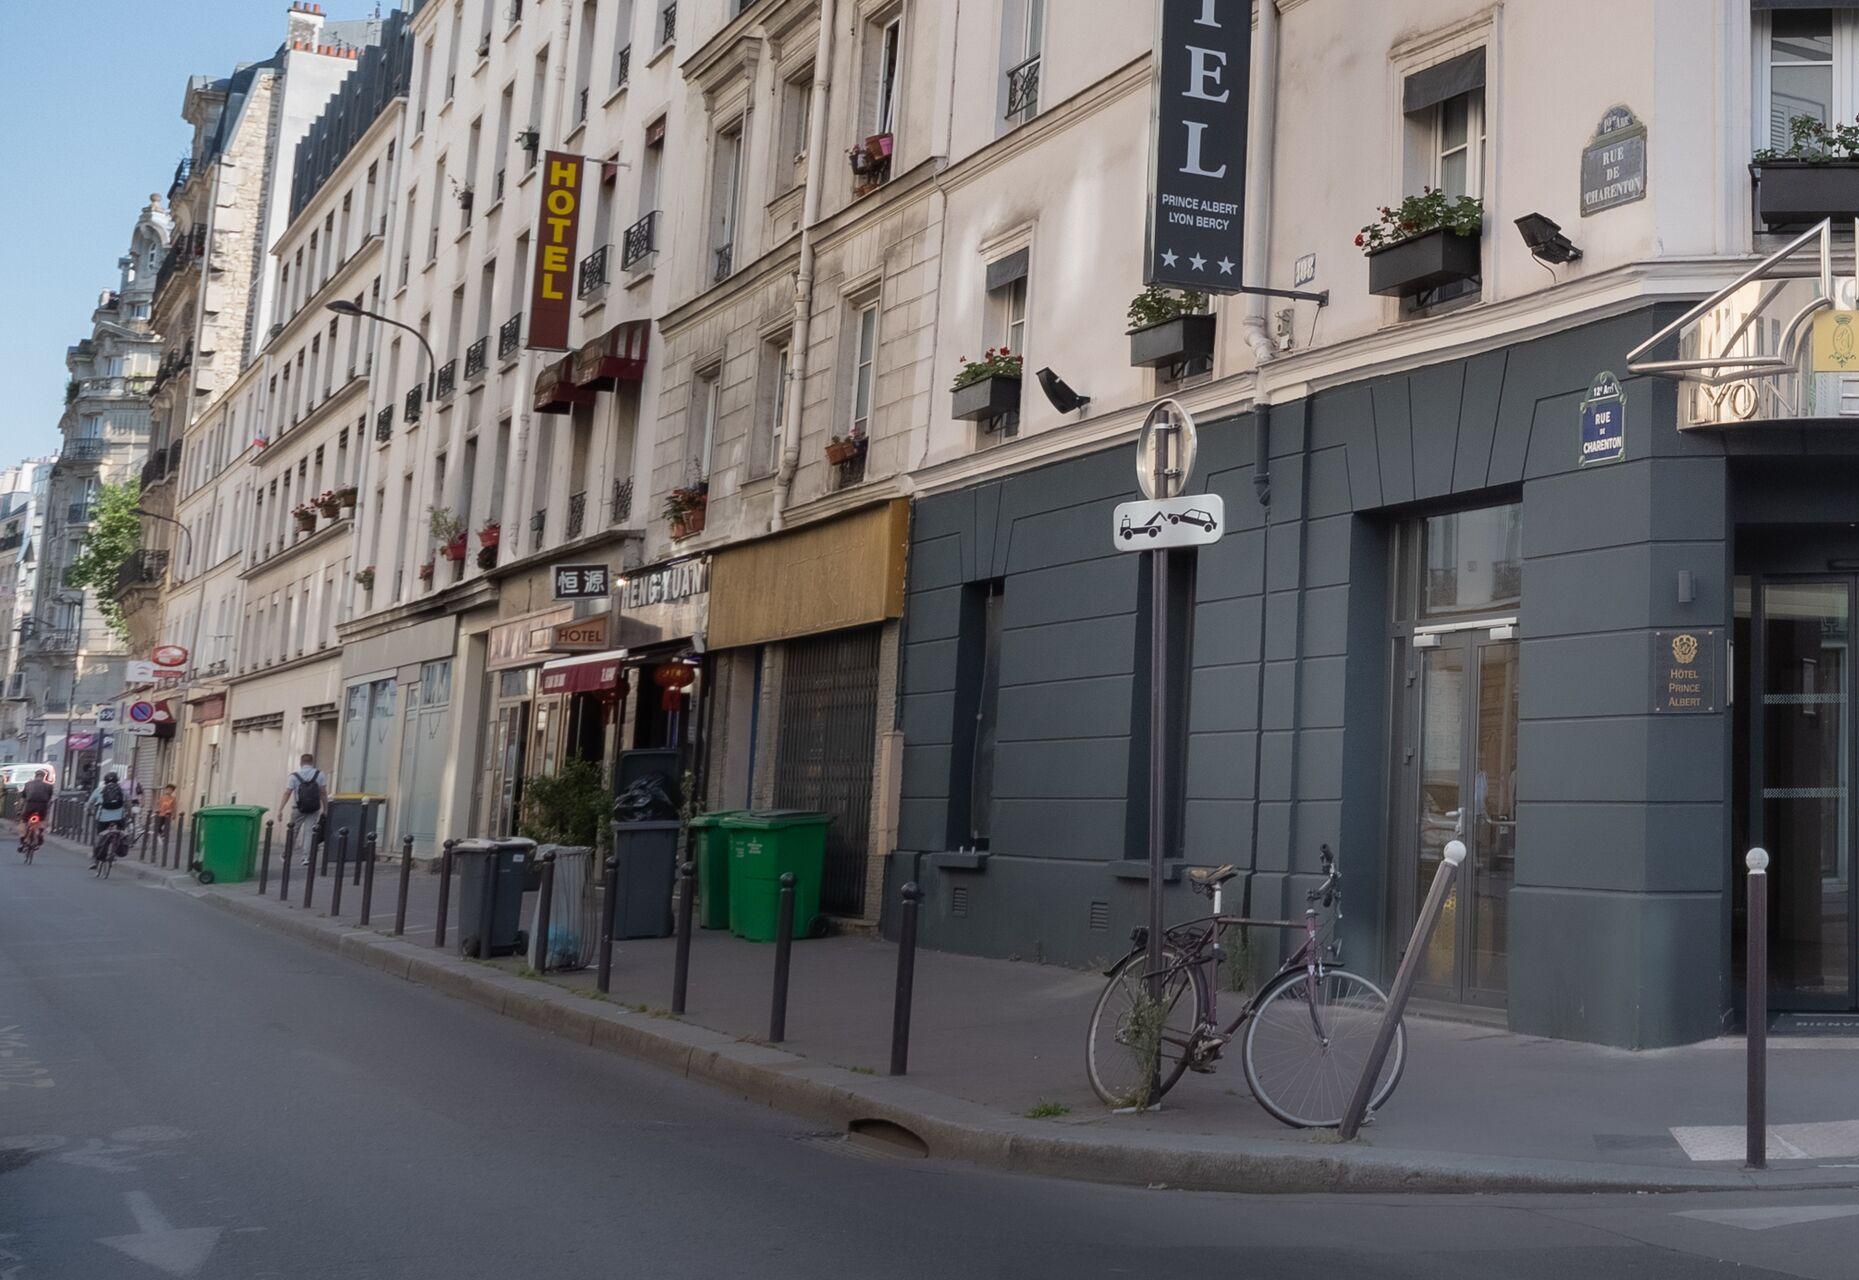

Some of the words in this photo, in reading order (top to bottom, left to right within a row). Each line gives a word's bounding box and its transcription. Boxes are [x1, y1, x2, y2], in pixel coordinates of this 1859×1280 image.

[1602, 146, 1624, 166] RUE
[1606, 166, 1620, 181] DE
[1585, 176, 1641, 205] CHARENTON
[1161, 193, 1200, 210] PRINCE
[1200, 200, 1239, 216] ALBERT
[541, 160, 577, 300] HOTEL
[1168, 211, 1194, 226] LYON
[1195, 215, 1230, 231] BERCY
[1296, 256, 1315, 284] 108
[1687, 377, 1800, 424] LYON
[1594, 411, 1612, 426] RUE
[1599, 427, 1606, 435] DE
[1583, 435, 1623, 454] CHARENTON
[557, 570, 605, 594] 恒源
[558, 629, 604, 643] HOTEL
[1668, 682, 1701, 693] PRINCE
[1668, 696, 1701, 707] ALBERT
